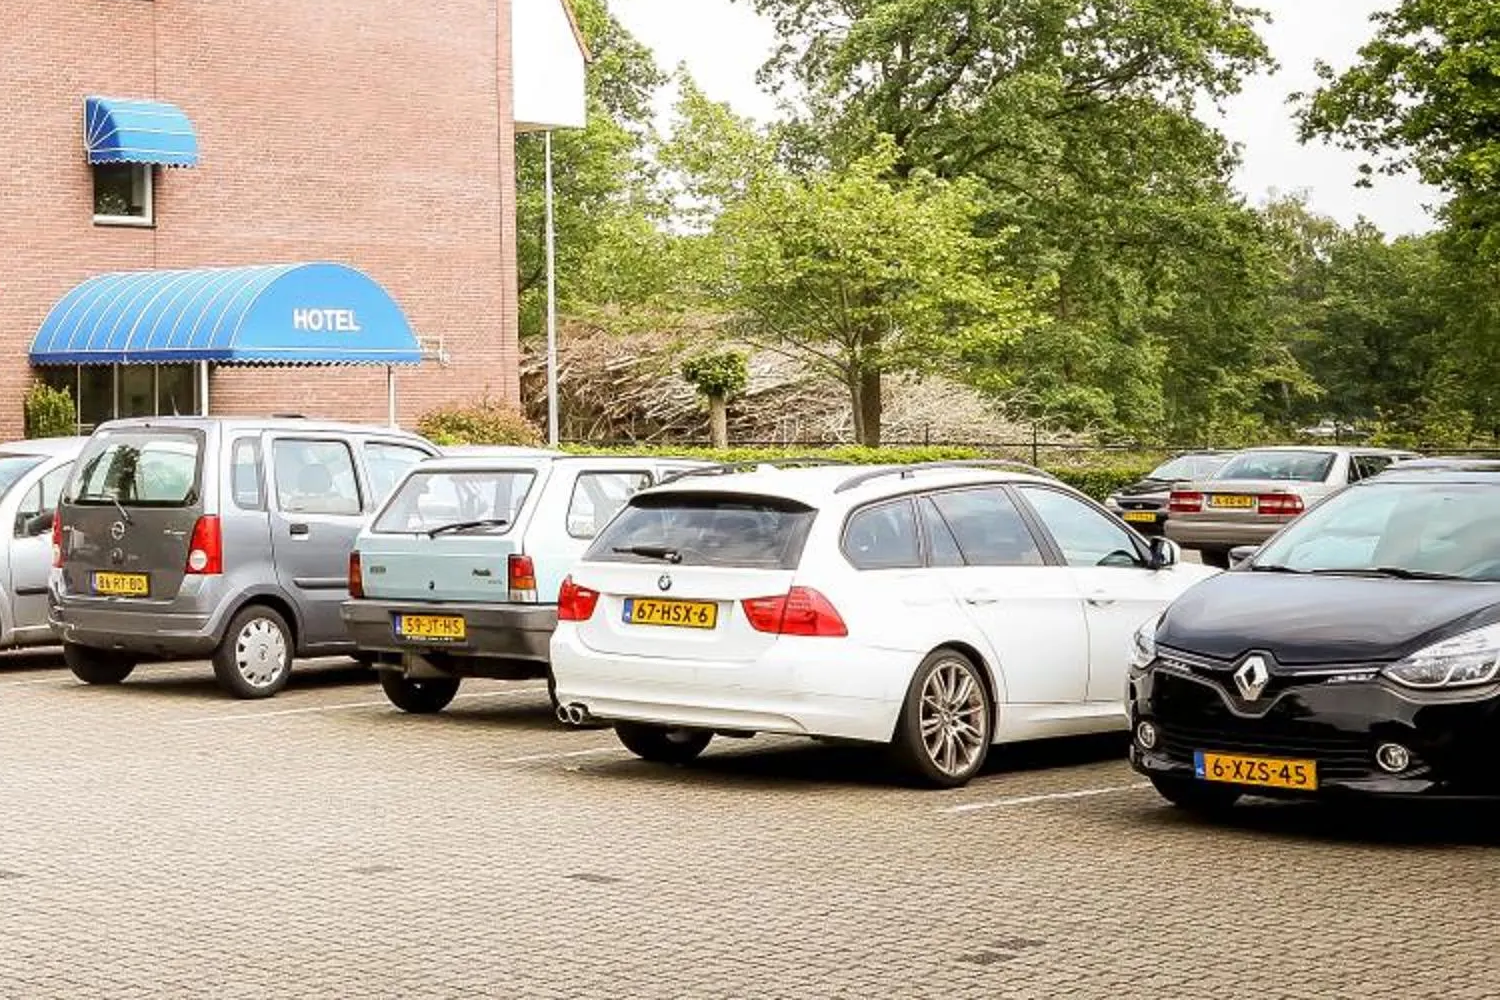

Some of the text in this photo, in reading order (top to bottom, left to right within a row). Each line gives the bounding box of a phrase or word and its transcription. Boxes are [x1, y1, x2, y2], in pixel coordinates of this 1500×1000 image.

[292, 308, 362, 332] HOTEL
[637, 602, 709, 624] 67-HSX-6
[1213, 757, 1308, 786] 6-XZS-45
